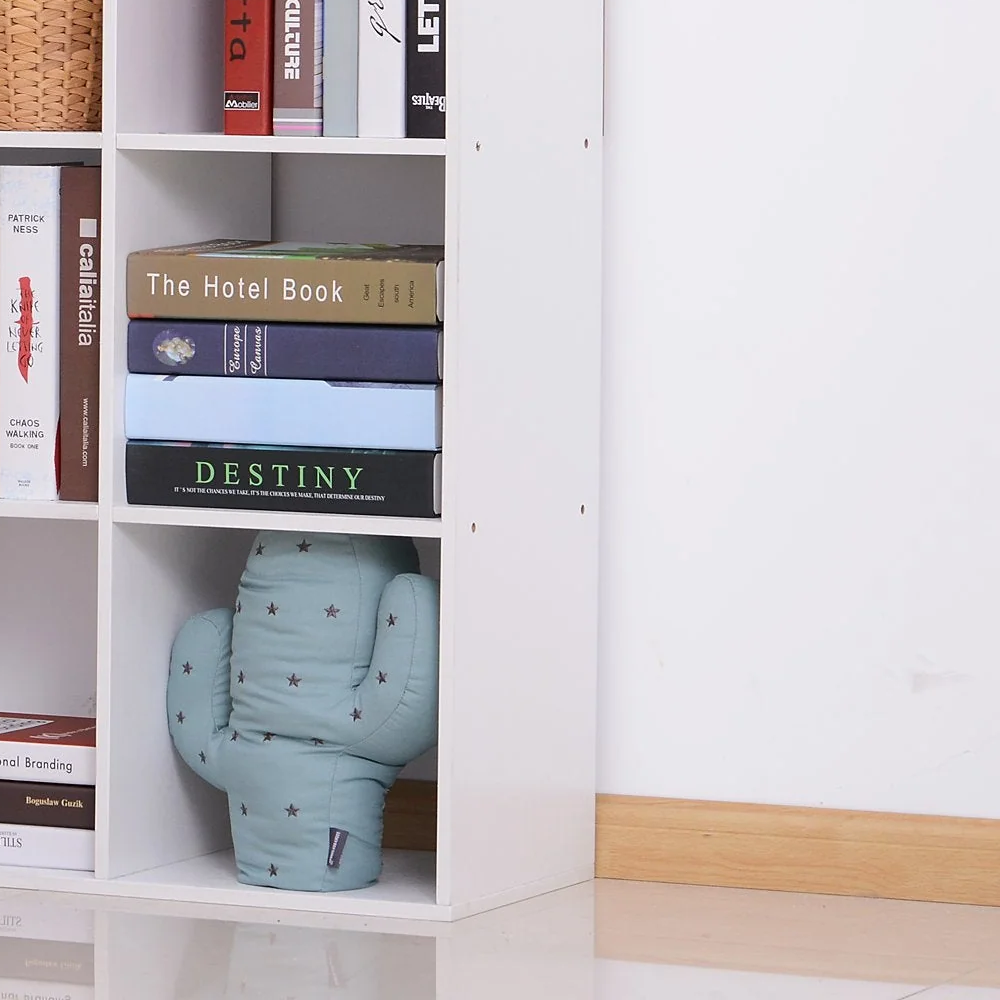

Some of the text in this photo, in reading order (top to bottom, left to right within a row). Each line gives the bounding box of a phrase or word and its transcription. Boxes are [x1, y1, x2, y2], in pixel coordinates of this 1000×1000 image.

[8, 214, 45, 223] PATRICK
[13, 224, 39, 234] NESS
[147, 273, 343, 303] The Hotel Book
[229, 326, 243, 373] Europe
[250, 326, 262, 374] Canvas
[9, 418, 40, 428] CHAOS
[5, 430, 44, 438] WALKING
[195, 461, 363, 490] DESTINY
[25, 757, 73, 774] Branding
[61, 799, 83, 809] Guzik
